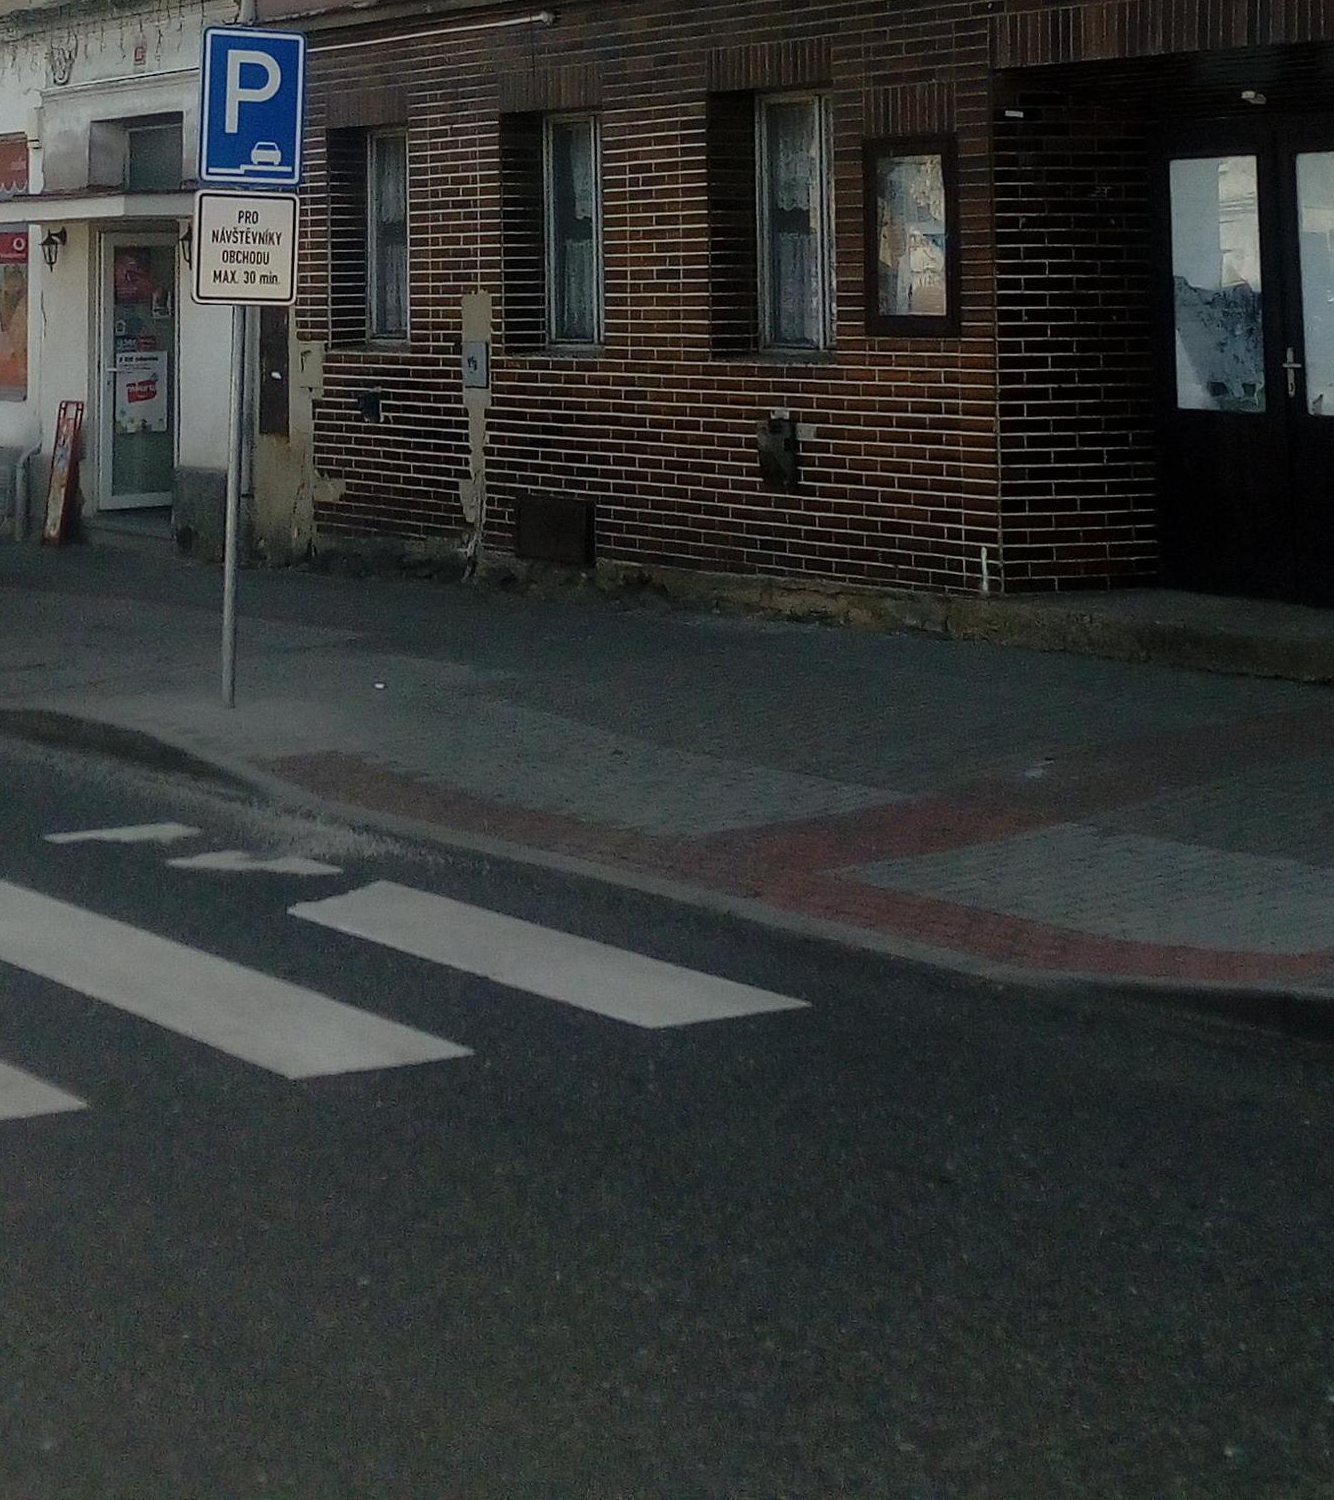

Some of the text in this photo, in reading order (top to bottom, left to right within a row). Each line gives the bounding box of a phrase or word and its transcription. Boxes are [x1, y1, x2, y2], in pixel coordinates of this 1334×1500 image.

[225, 49, 281, 134] P
[237, 210, 259, 225] PRO
[211, 226, 283, 246] NÁVŠTĚVNÍKY
[221, 249, 270, 265] OBCHODU
[212, 269, 240, 284] MAX.
[243, 270, 256, 285] 30
